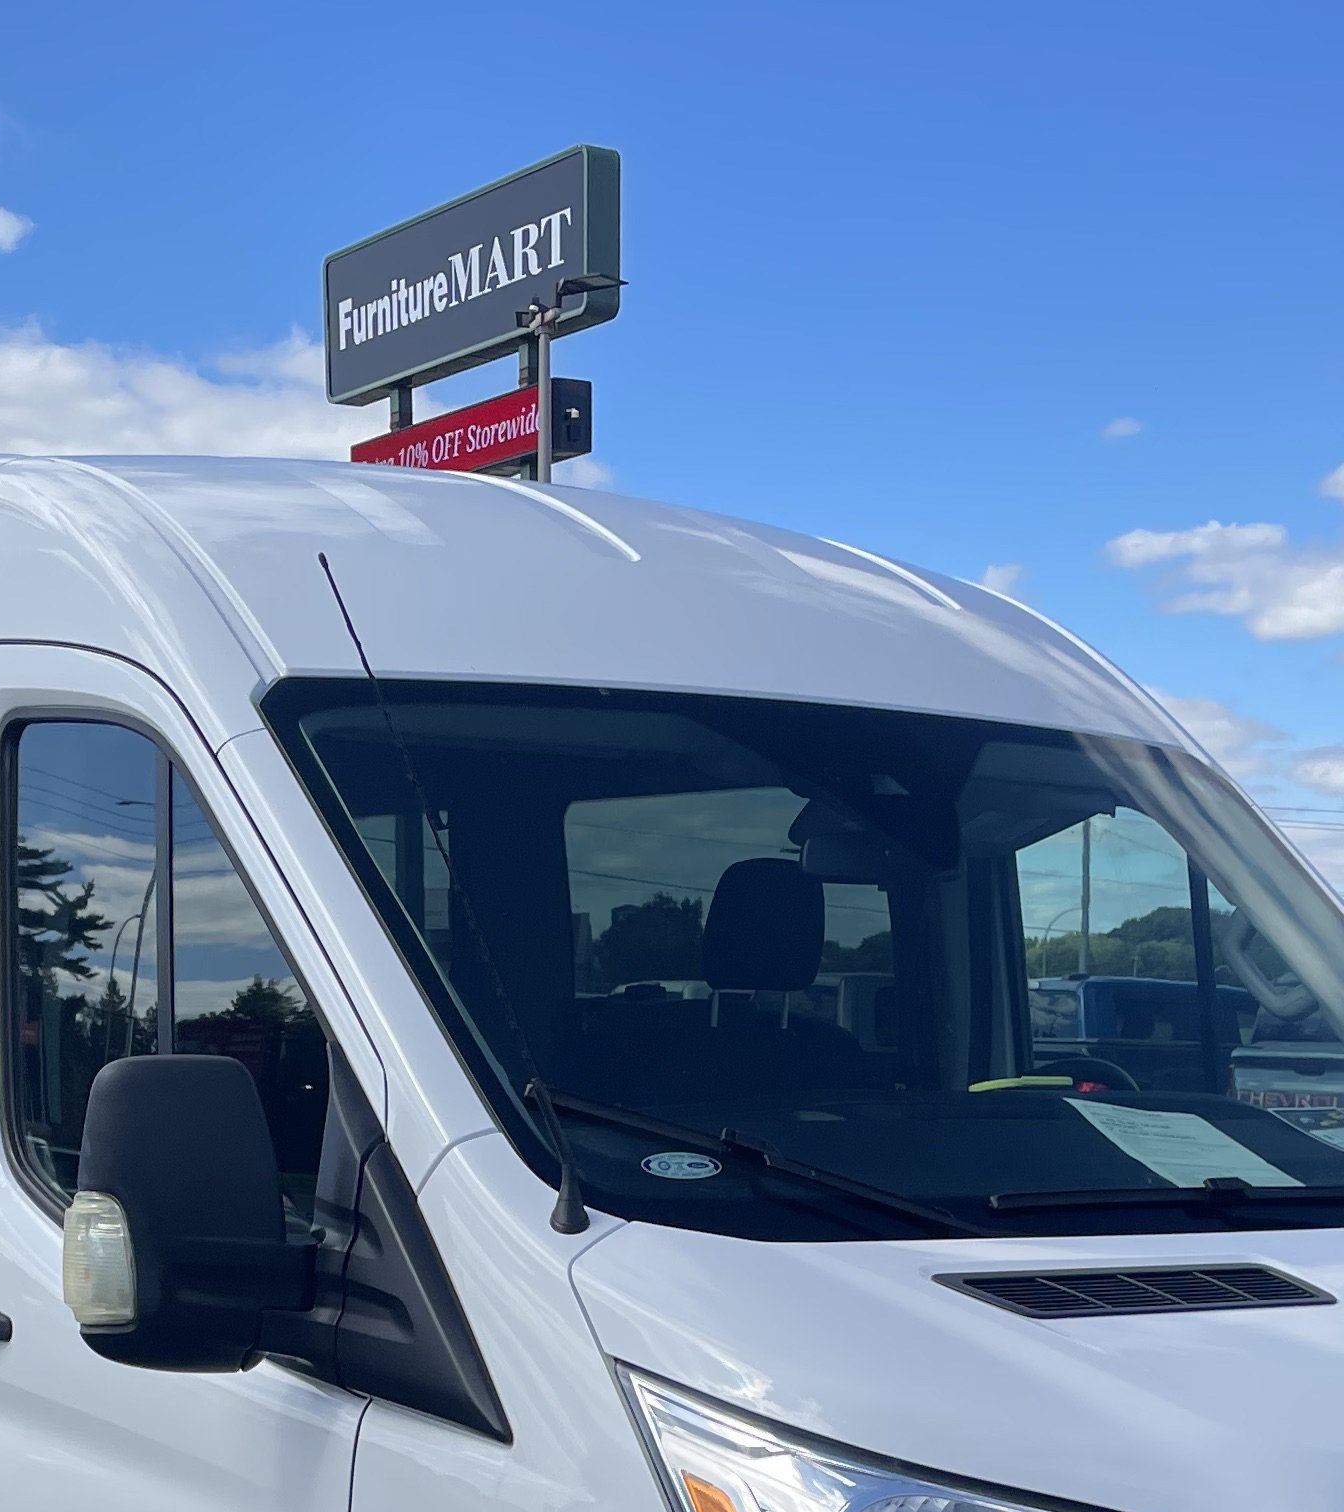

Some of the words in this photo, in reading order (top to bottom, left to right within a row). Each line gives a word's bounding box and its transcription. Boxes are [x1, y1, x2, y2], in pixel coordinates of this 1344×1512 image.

[338, 207, 572, 351] FurnitureMART
[399, 440, 429, 468] 10%
[432, 428, 464, 464] OFF
